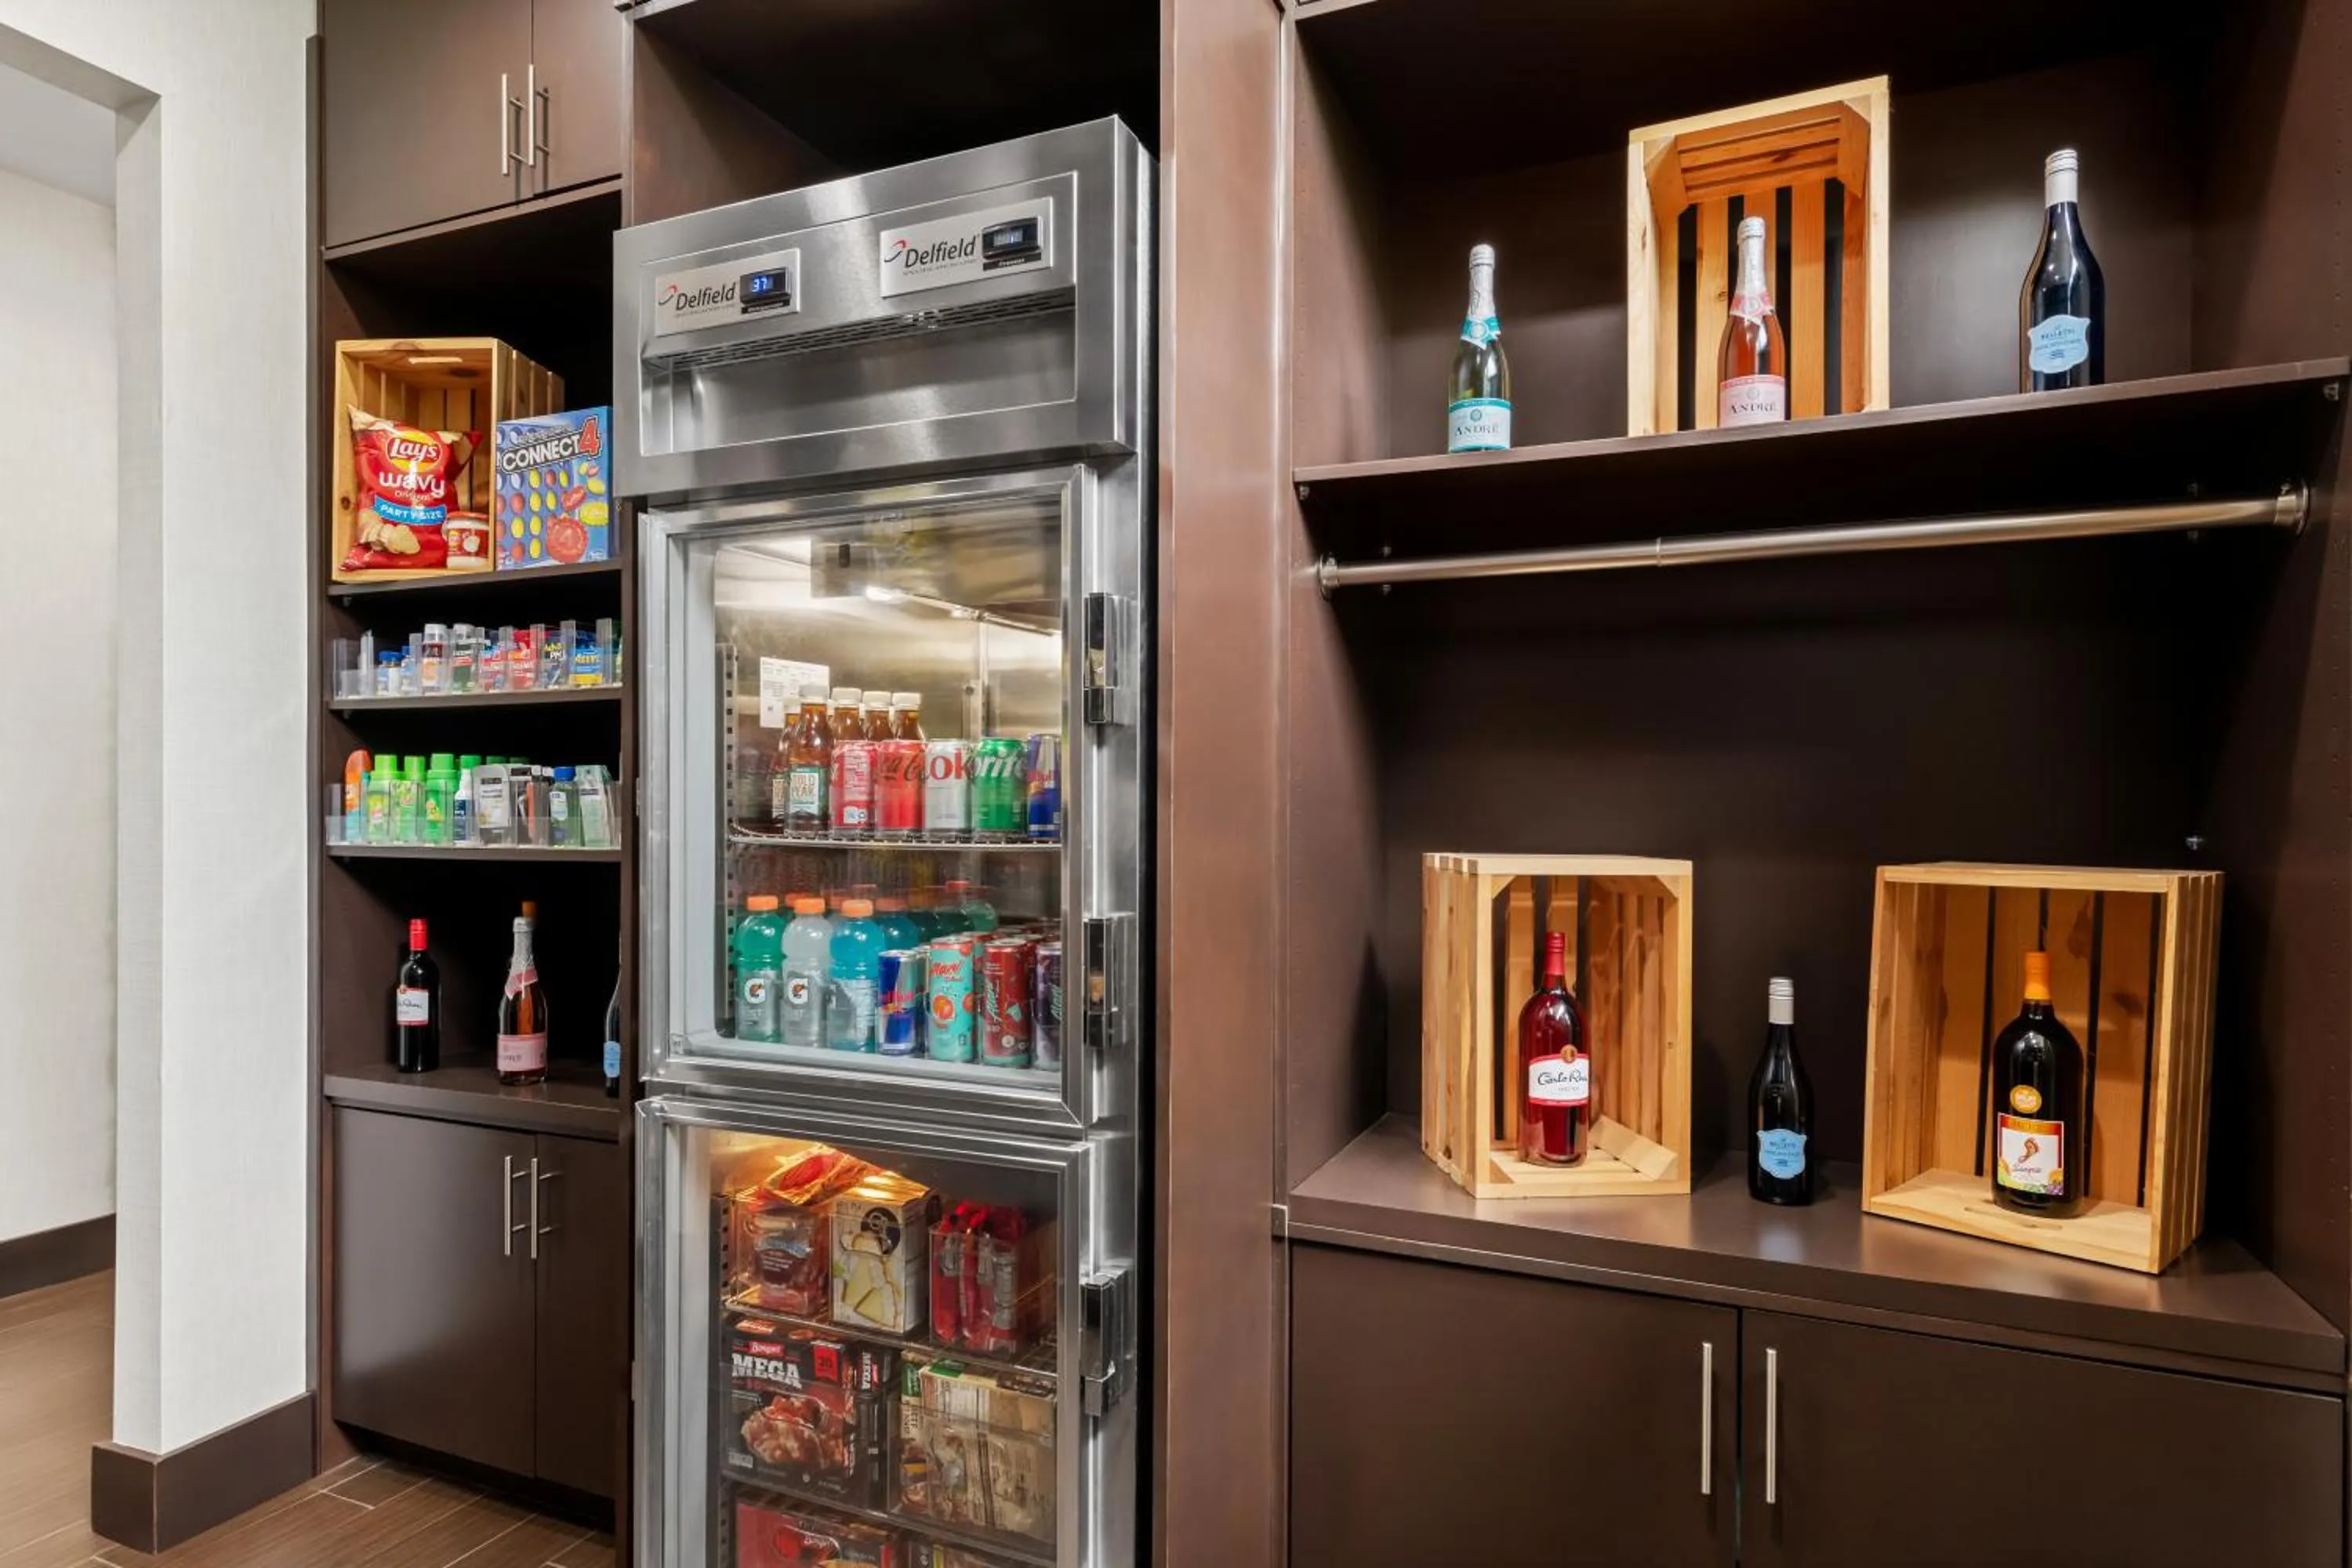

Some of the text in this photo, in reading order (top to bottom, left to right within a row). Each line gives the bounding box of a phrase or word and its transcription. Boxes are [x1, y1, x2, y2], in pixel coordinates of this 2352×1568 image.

[905, 235, 977, 269] Delfield
[676, 281, 737, 311] Delfield
[753, 278, 768, 292] 37
[503, 434, 580, 470] CONNECT
[579, 416, 600, 456] 4
[1537, 1072, 1568, 1086] Carlo
[731, 1352, 803, 1390] MEGA
